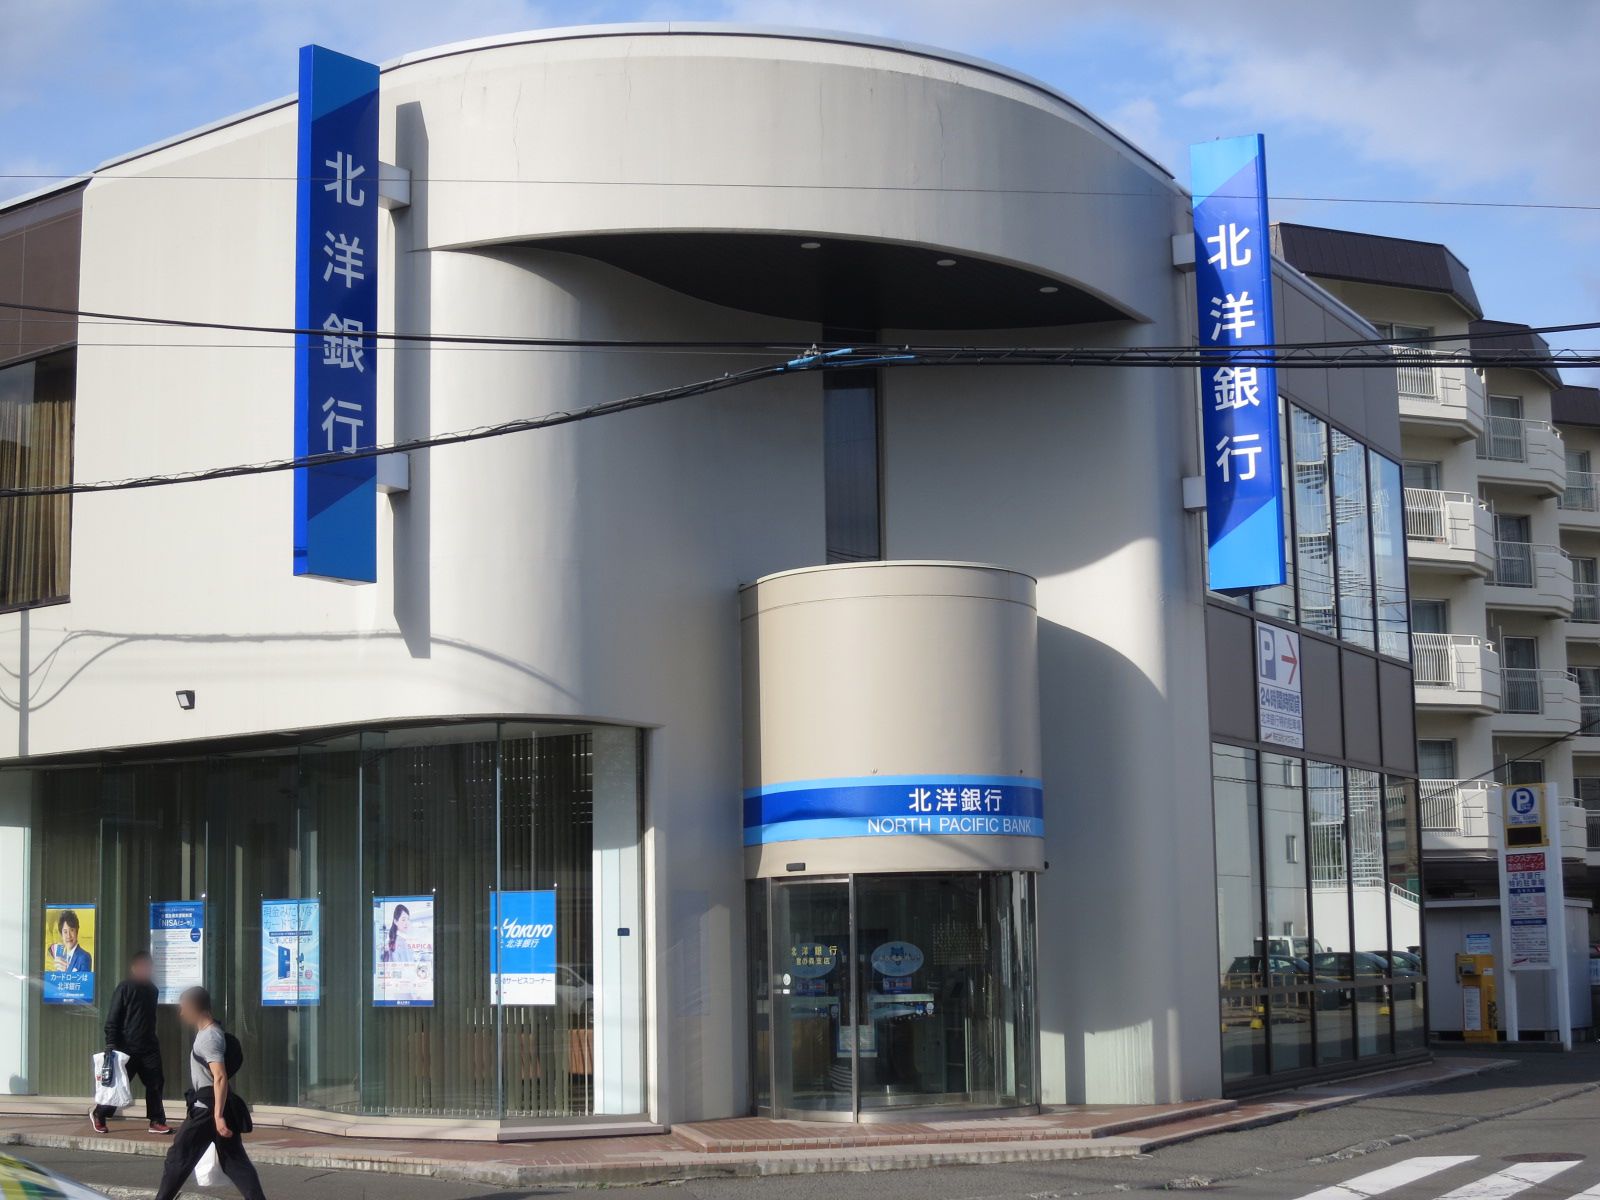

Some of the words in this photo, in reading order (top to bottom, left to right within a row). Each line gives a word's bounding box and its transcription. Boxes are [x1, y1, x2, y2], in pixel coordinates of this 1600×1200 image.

[321, 151, 366, 454] 北洋銀行
[1206, 222, 1263, 483] 北洋銀行
[908, 787, 1003, 812] 北洋銀行
[868, 818, 931, 833] NORTH
[939, 818, 999, 833] PACIFIC
[1003, 818, 1032, 833] BANK
[506, 939, 541, 949] 北洋銀行
